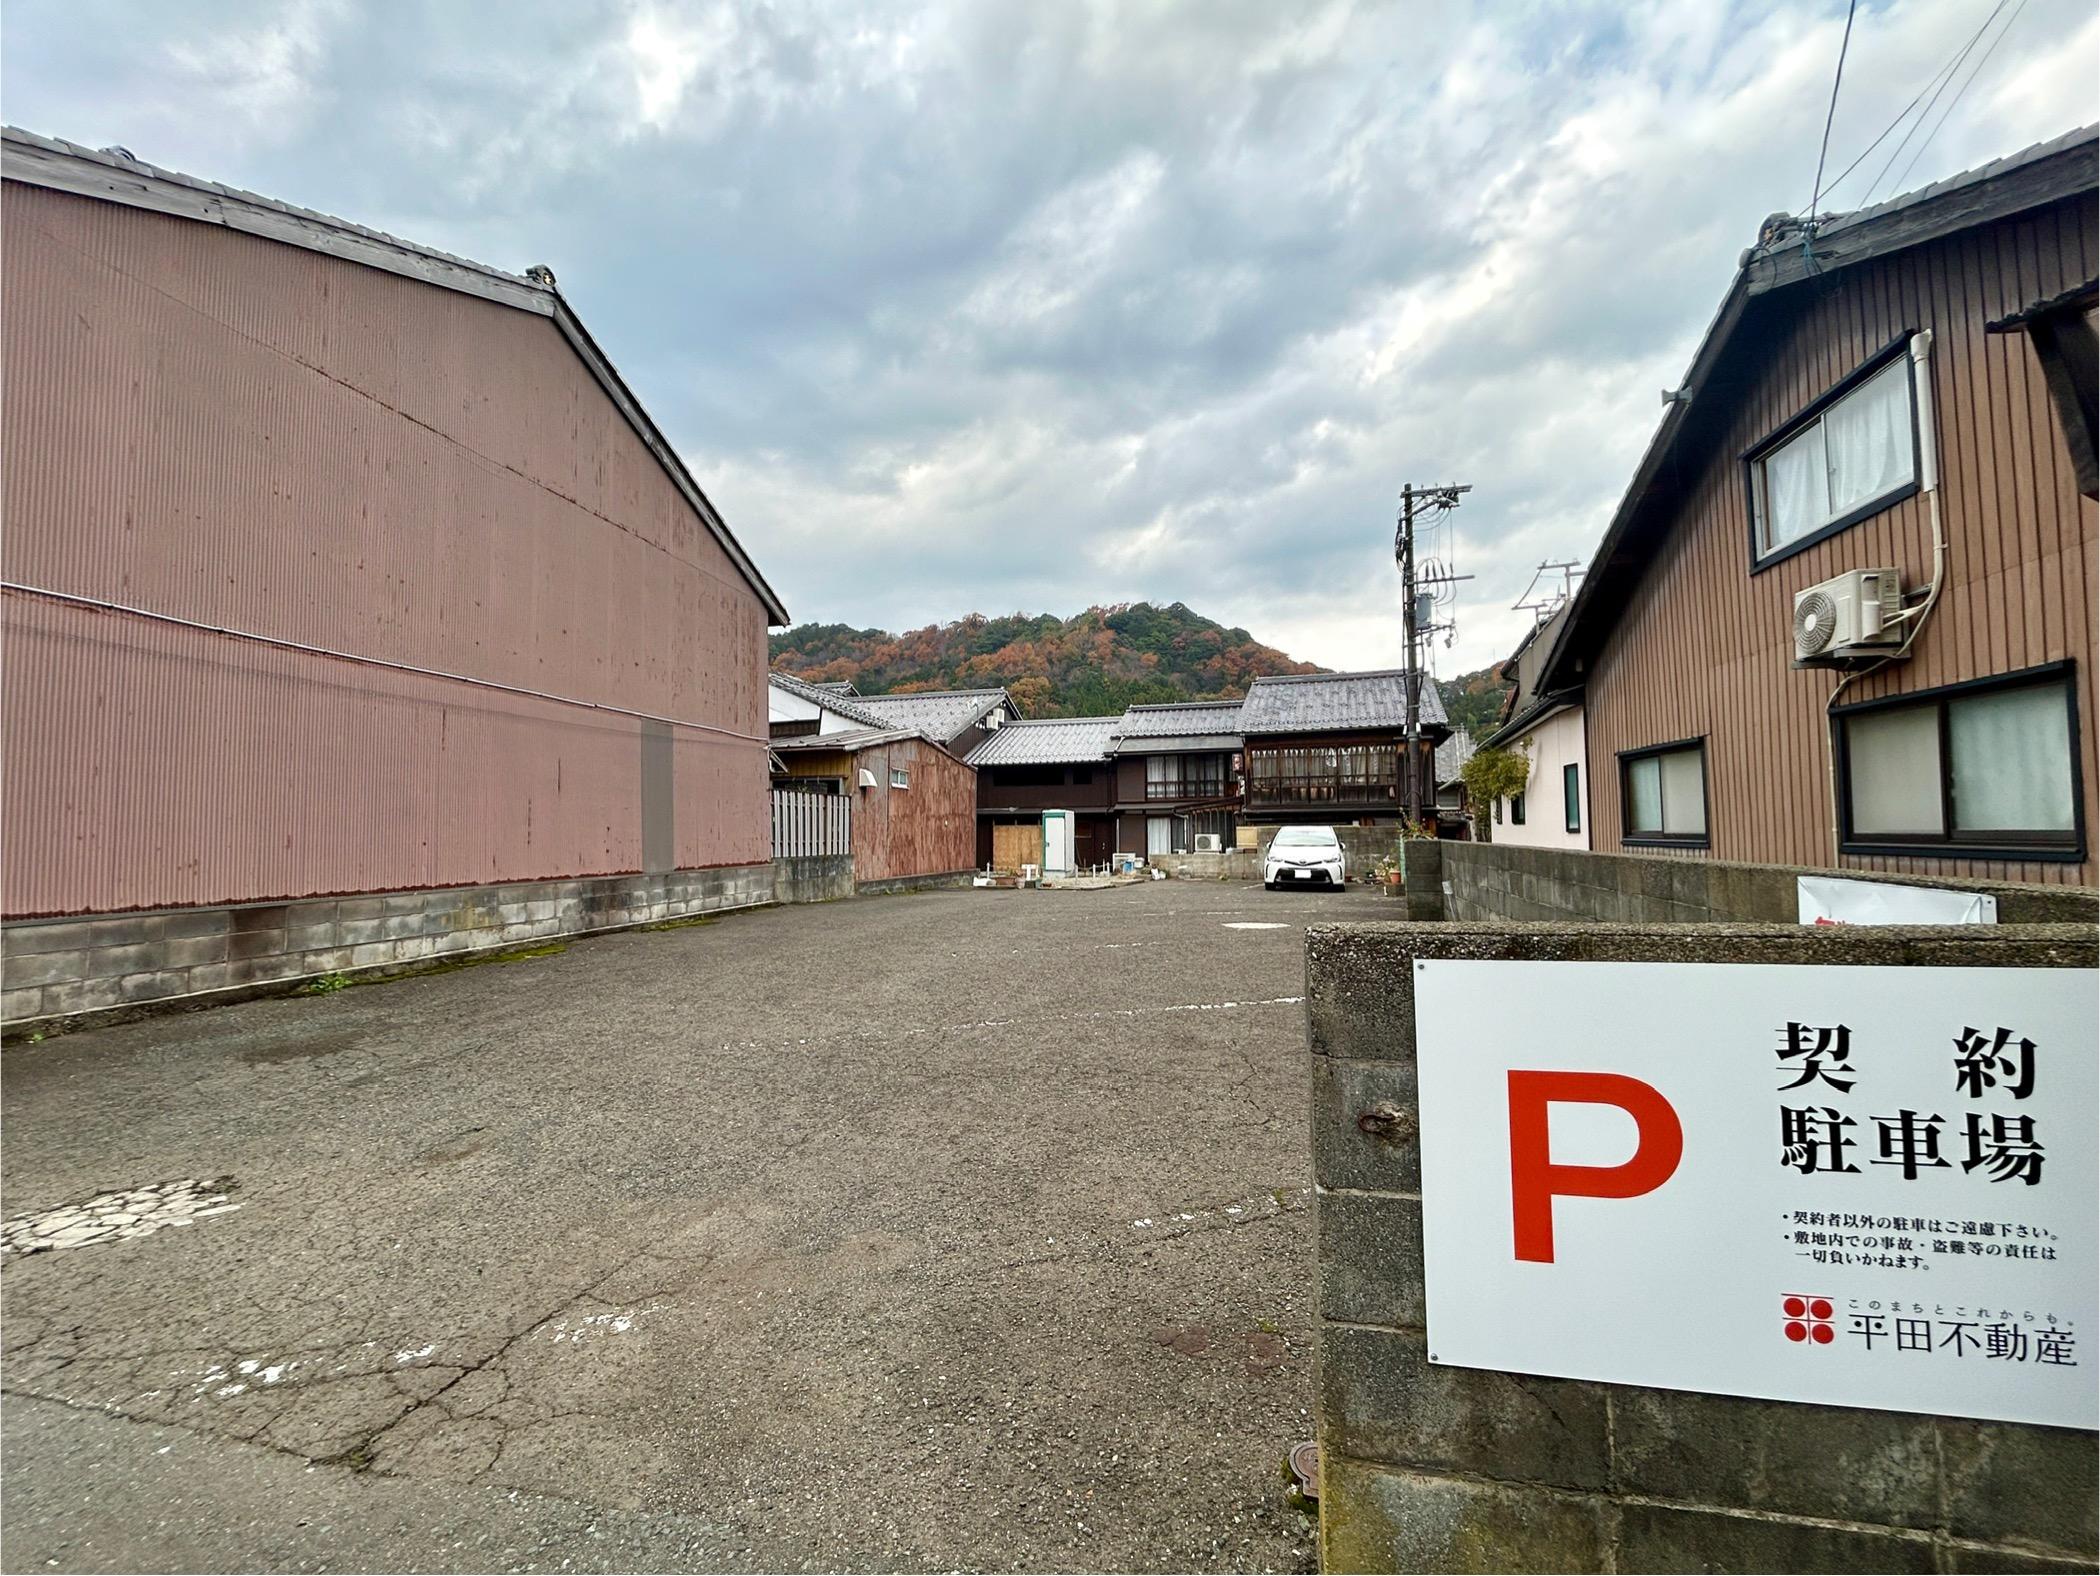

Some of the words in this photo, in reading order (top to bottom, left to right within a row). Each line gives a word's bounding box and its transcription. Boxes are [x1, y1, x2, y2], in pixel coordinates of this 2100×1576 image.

[1776, 1021, 2038, 1100] 契約
[1506, 1069, 1684, 1264] P
[1780, 1104, 2046, 1187] 駐車場
[1796, 1248, 1930, 1271] 一切負いかねます。
[1847, 1313, 2079, 1367] 平田不動産
[1848, 1298, 2074, 1327] このまちとこれからも。
